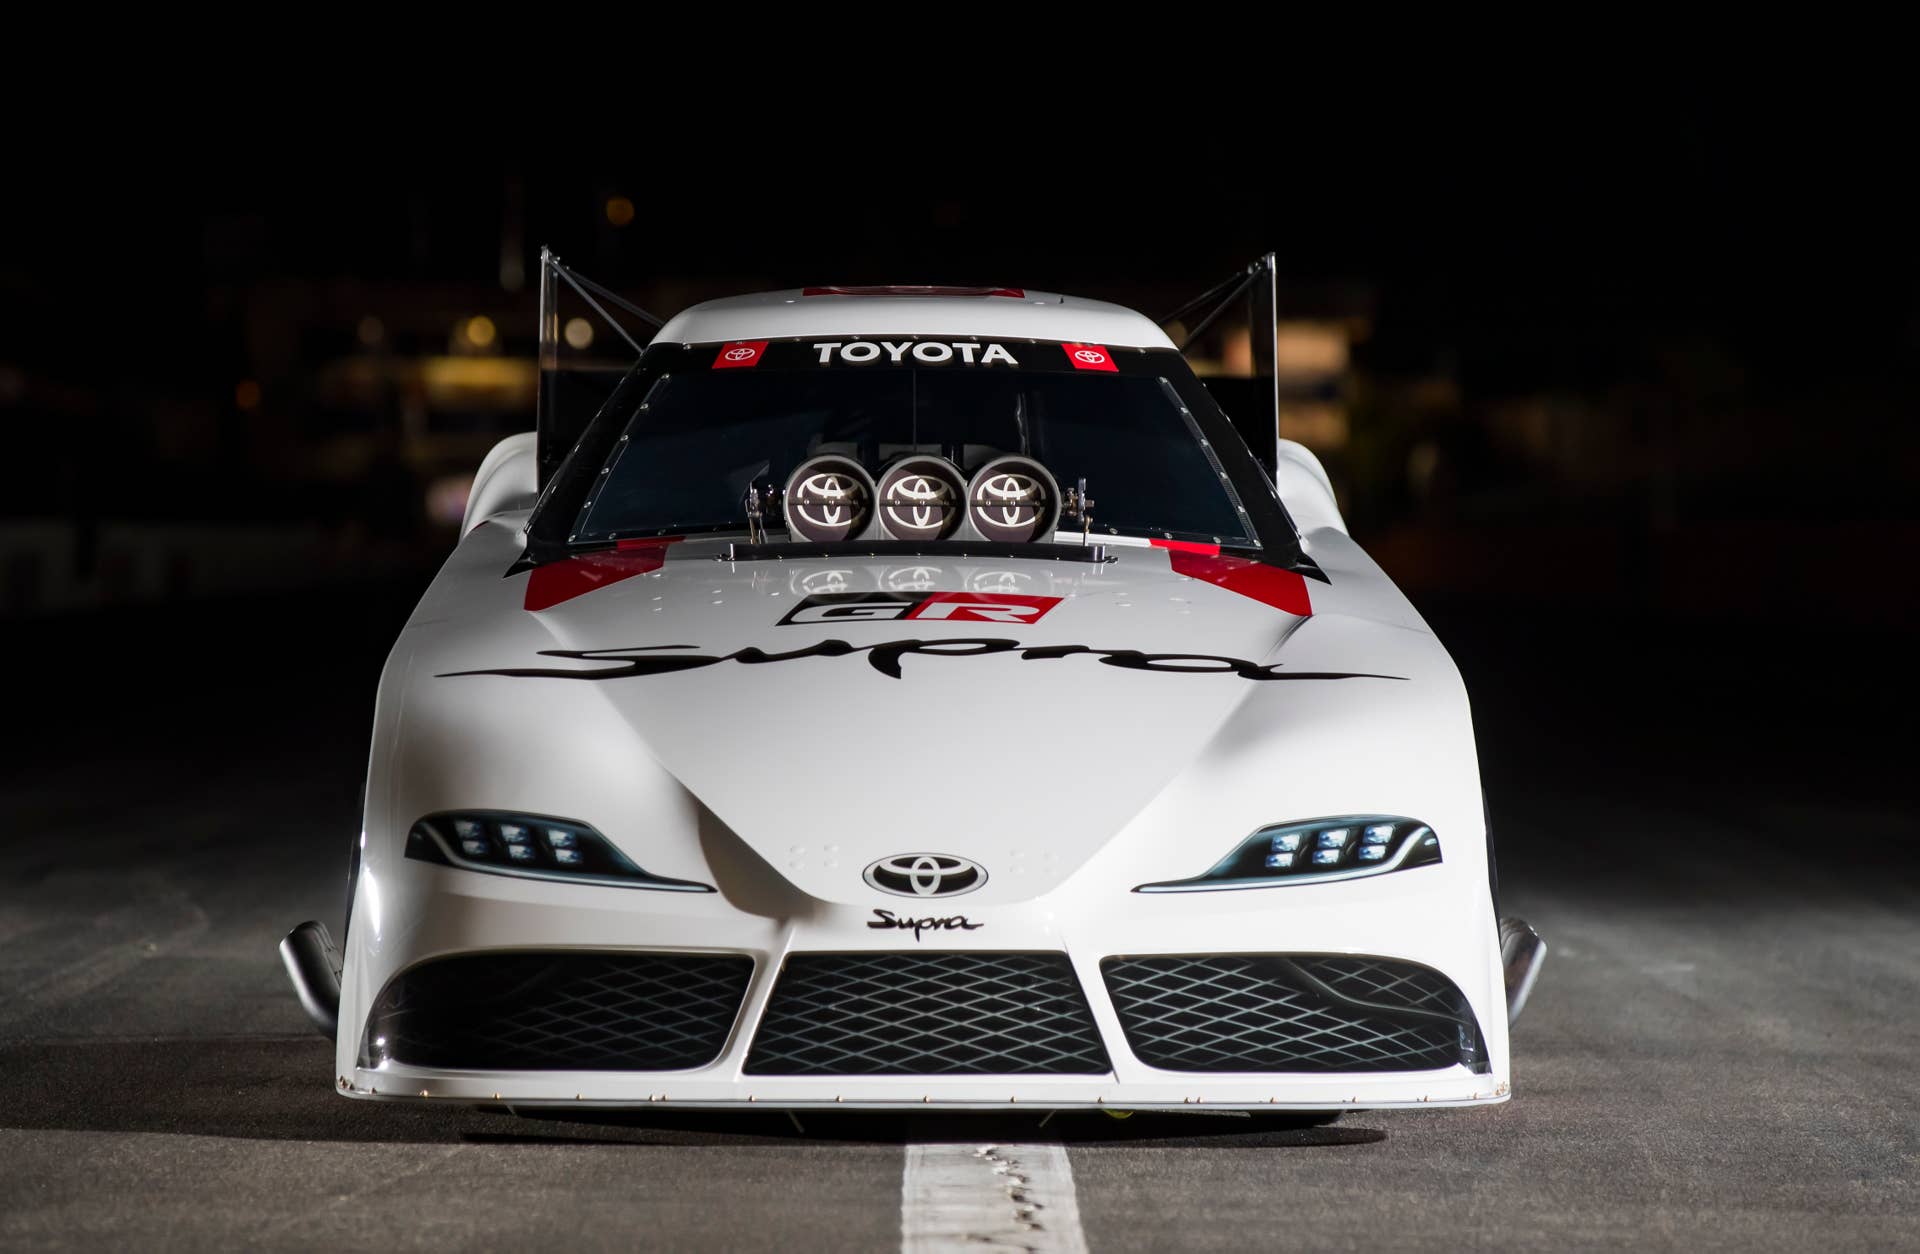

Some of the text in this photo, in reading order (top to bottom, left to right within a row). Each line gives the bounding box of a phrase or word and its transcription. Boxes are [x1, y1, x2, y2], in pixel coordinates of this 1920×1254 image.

[813, 342, 1019, 367] TOYOTA
[787, 599, 1045, 625] GR
[434, 637, 1410, 681] Supra
[866, 908, 985, 943] Supra
